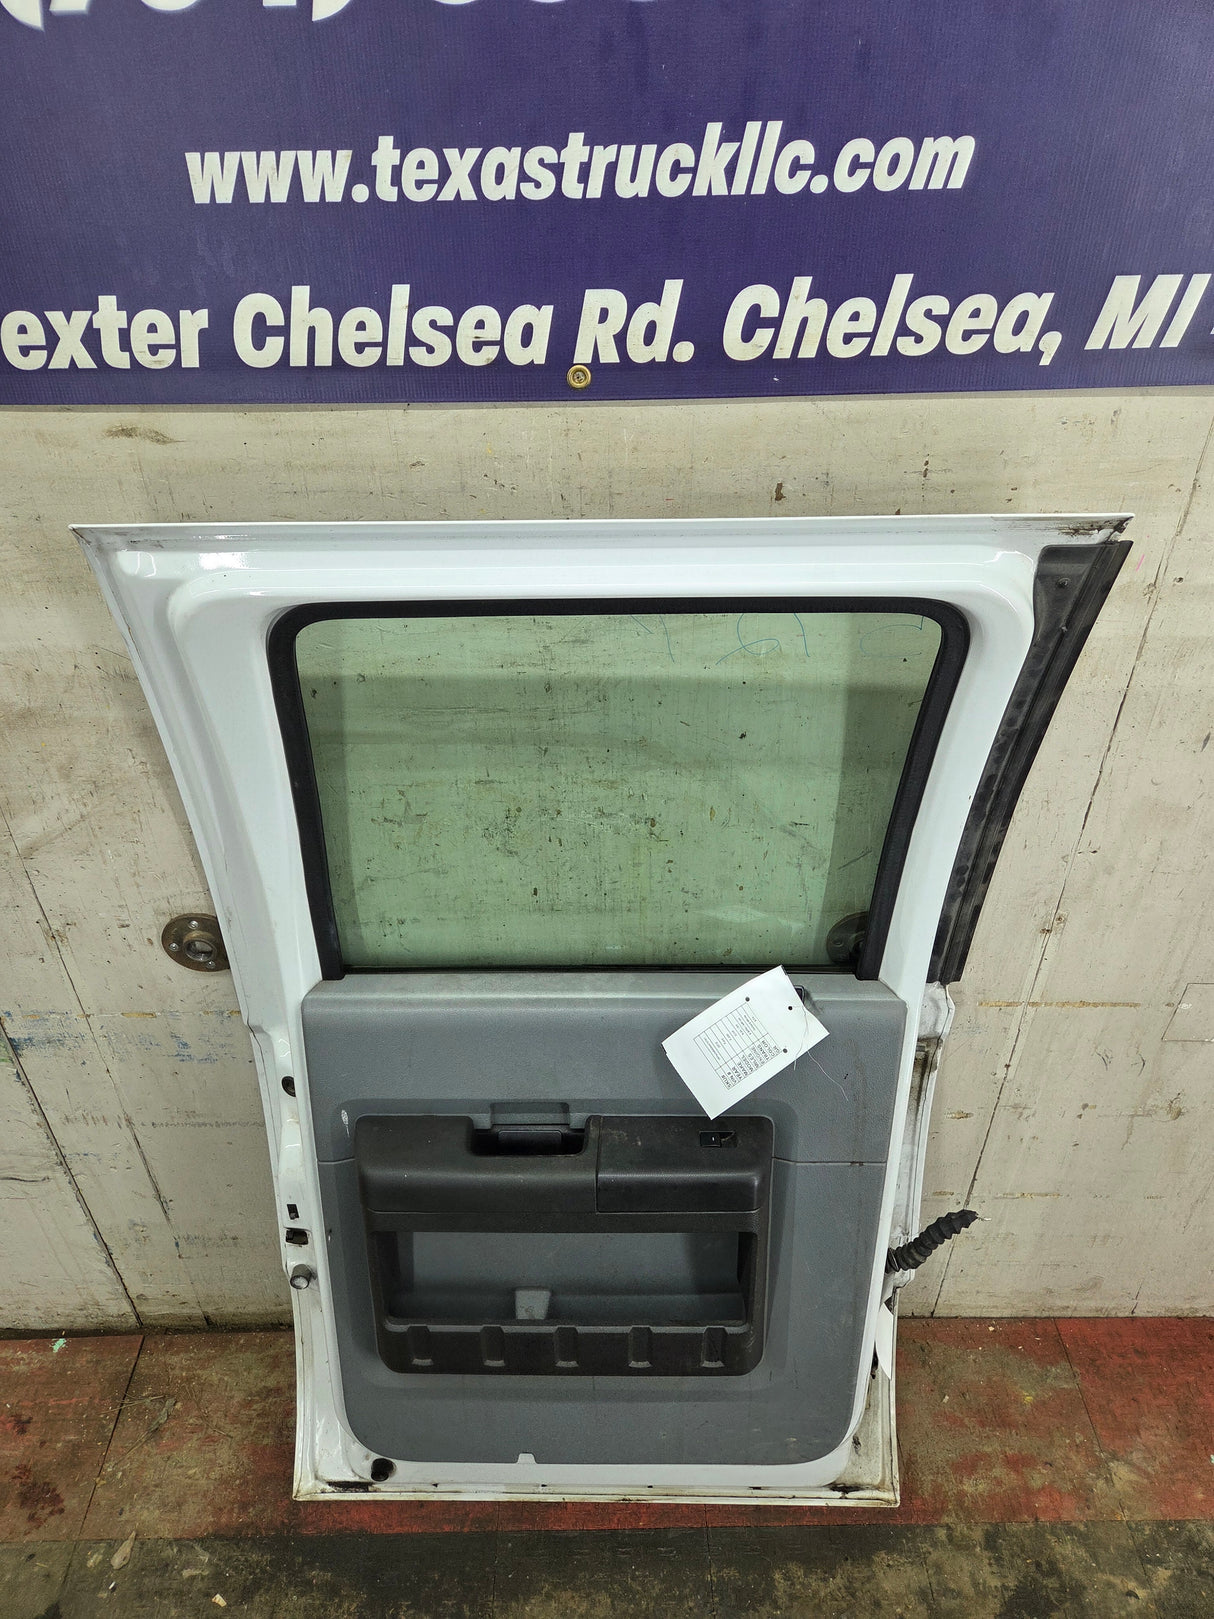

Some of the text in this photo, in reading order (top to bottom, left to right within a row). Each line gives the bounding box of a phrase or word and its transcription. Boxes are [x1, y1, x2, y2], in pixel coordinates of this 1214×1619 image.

[185, 120, 976, 204] www.texastruckllc.com
[233, 284, 555, 369] Chelsea
[572, 278, 695, 365] Rd.
[722, 273, 1063, 366] Chelsea,
[1084, 273, 1212, 351] MI
